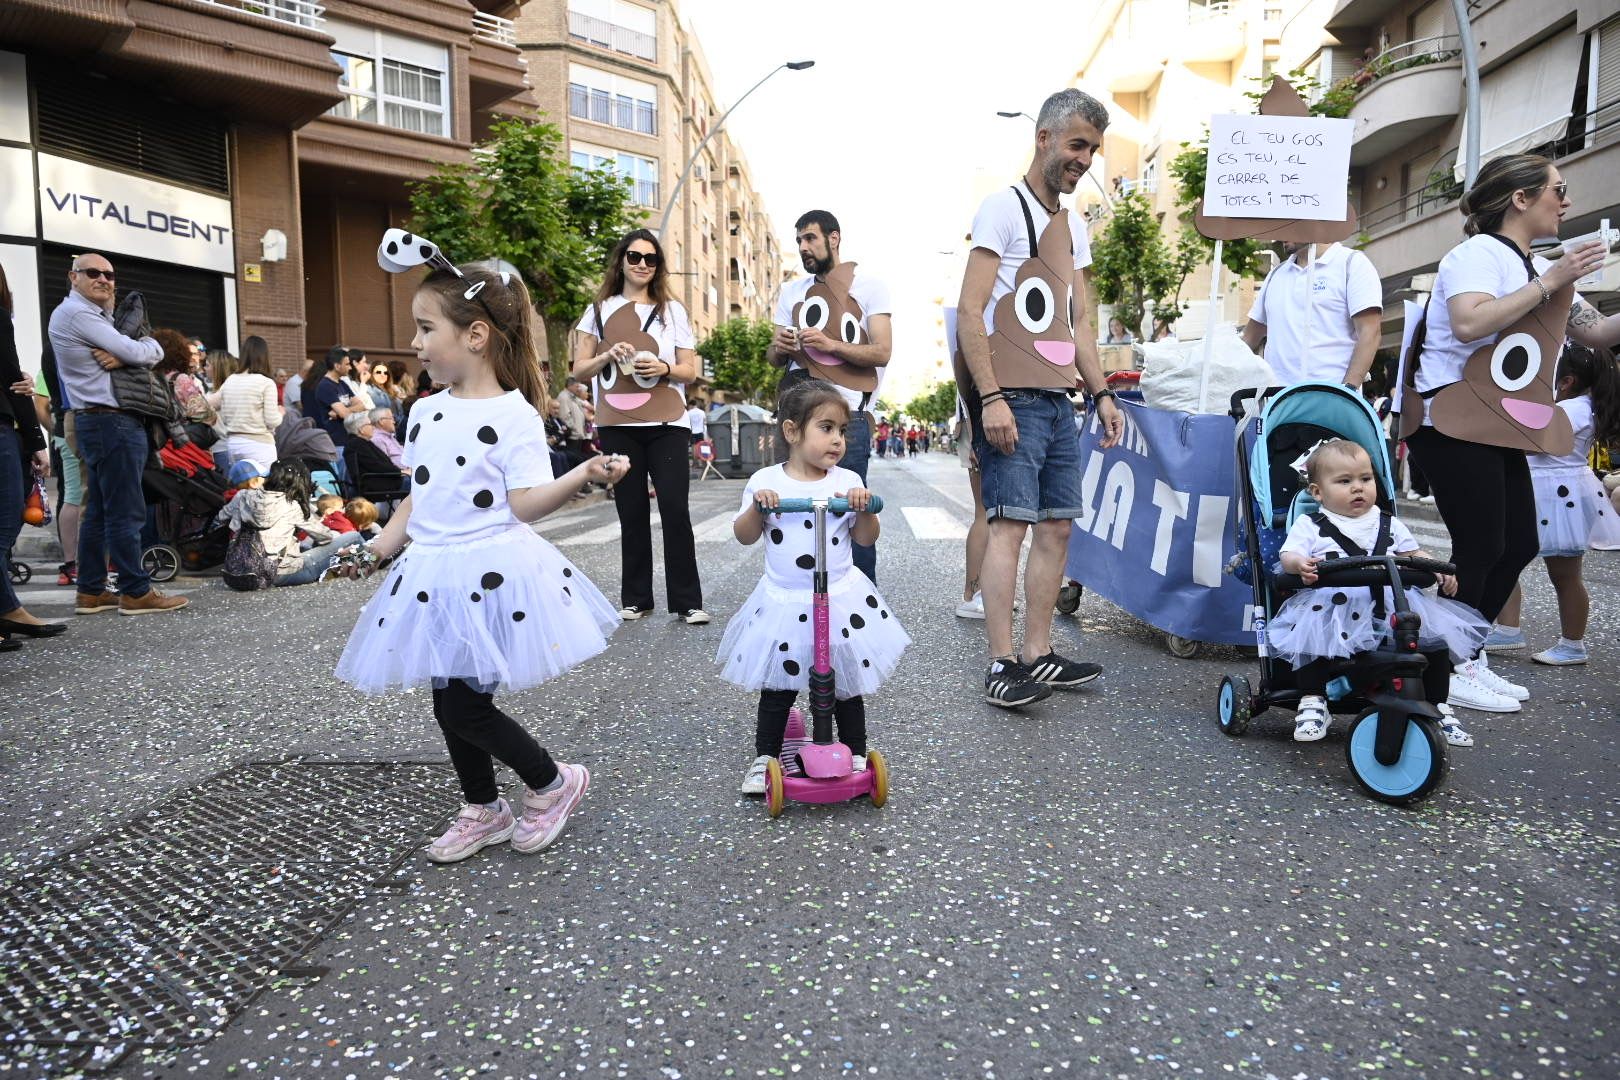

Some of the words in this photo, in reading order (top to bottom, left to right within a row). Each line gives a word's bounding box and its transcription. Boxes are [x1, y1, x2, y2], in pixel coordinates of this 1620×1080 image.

[1231, 130, 1250, 145] EL
[1258, 132, 1285, 145] TEU
[1292, 132, 1324, 147] GOS
[1217, 152, 1238, 165] ES
[1244, 152, 1278, 166] TEU,
[1284, 154, 1307, 165] EL
[1217, 172, 1269, 185] CARRER
[1280, 173, 1301, 185] DE
[1221, 194, 1261, 207] TOTES
[1280, 193, 1320, 207] TOTS
[46, 187, 230, 245] VITALDENT
[1150, 478, 1243, 588] TI
[818, 607, 827, 632] CITY
[819, 637, 827, 665] PARK
